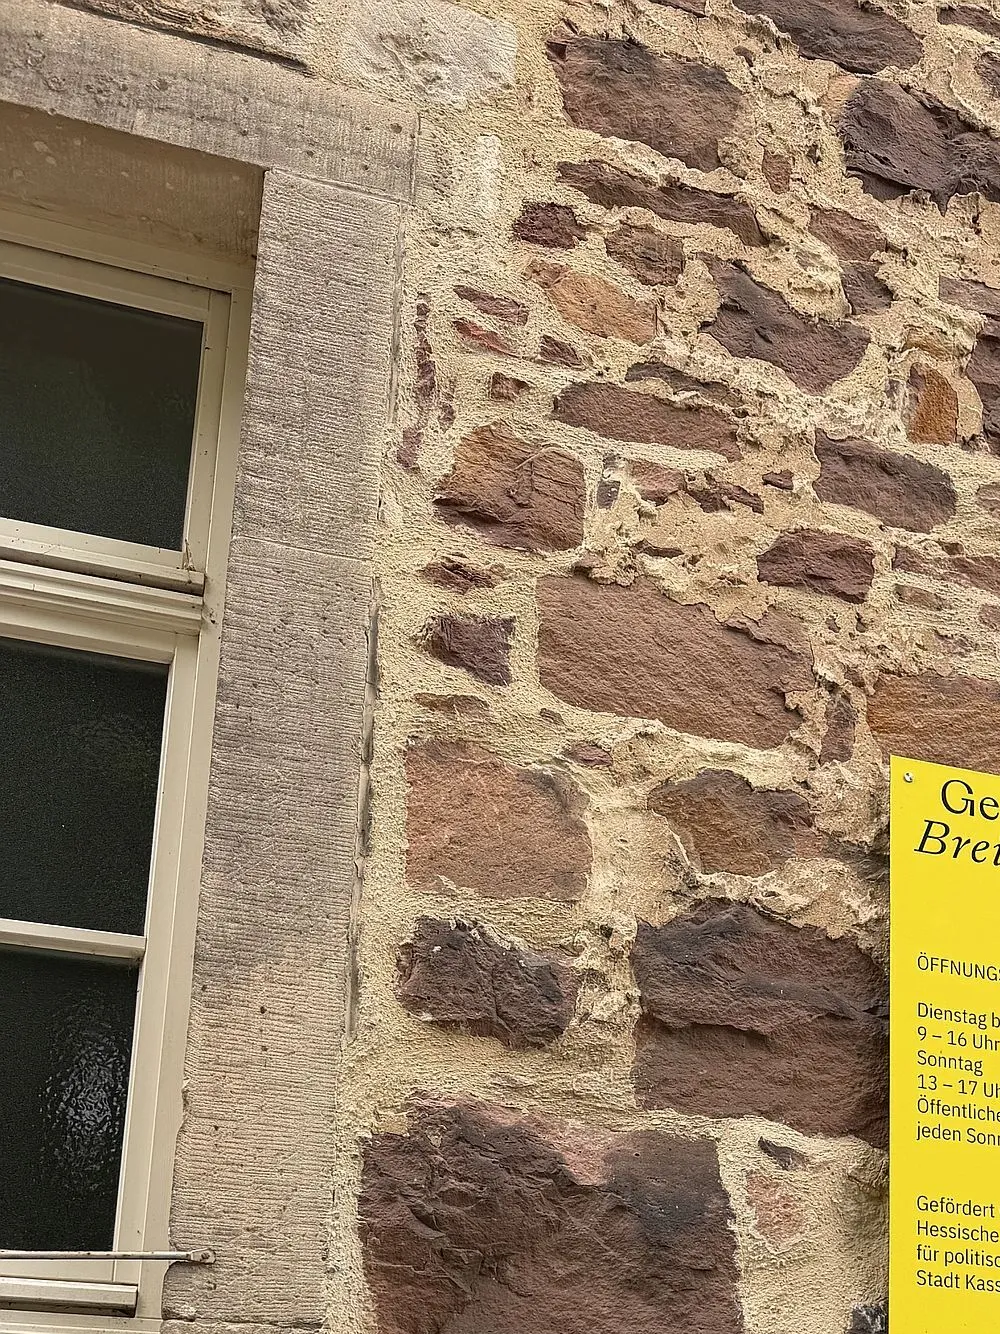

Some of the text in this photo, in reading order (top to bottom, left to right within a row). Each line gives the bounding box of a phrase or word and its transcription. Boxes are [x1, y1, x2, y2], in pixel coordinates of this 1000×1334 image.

[918, 1002, 987, 1030] Dienstag
[917, 1026, 927, 1041] 9
[947, 1031, 967, 1047] 16
[973, 1034, 1000, 1051] Uhr
[917, 1050, 983, 1077] Sonntag
[918, 1074, 937, 1090] 13
[958, 1079, 978, 1095] 17
[916, 1122, 961, 1141] jeden
[917, 1195, 995, 1218] Gefördert
[917, 1220, 999, 1243] Hessische
[916, 1244, 939, 1261] für
[917, 1270, 960, 1289] Stadt
